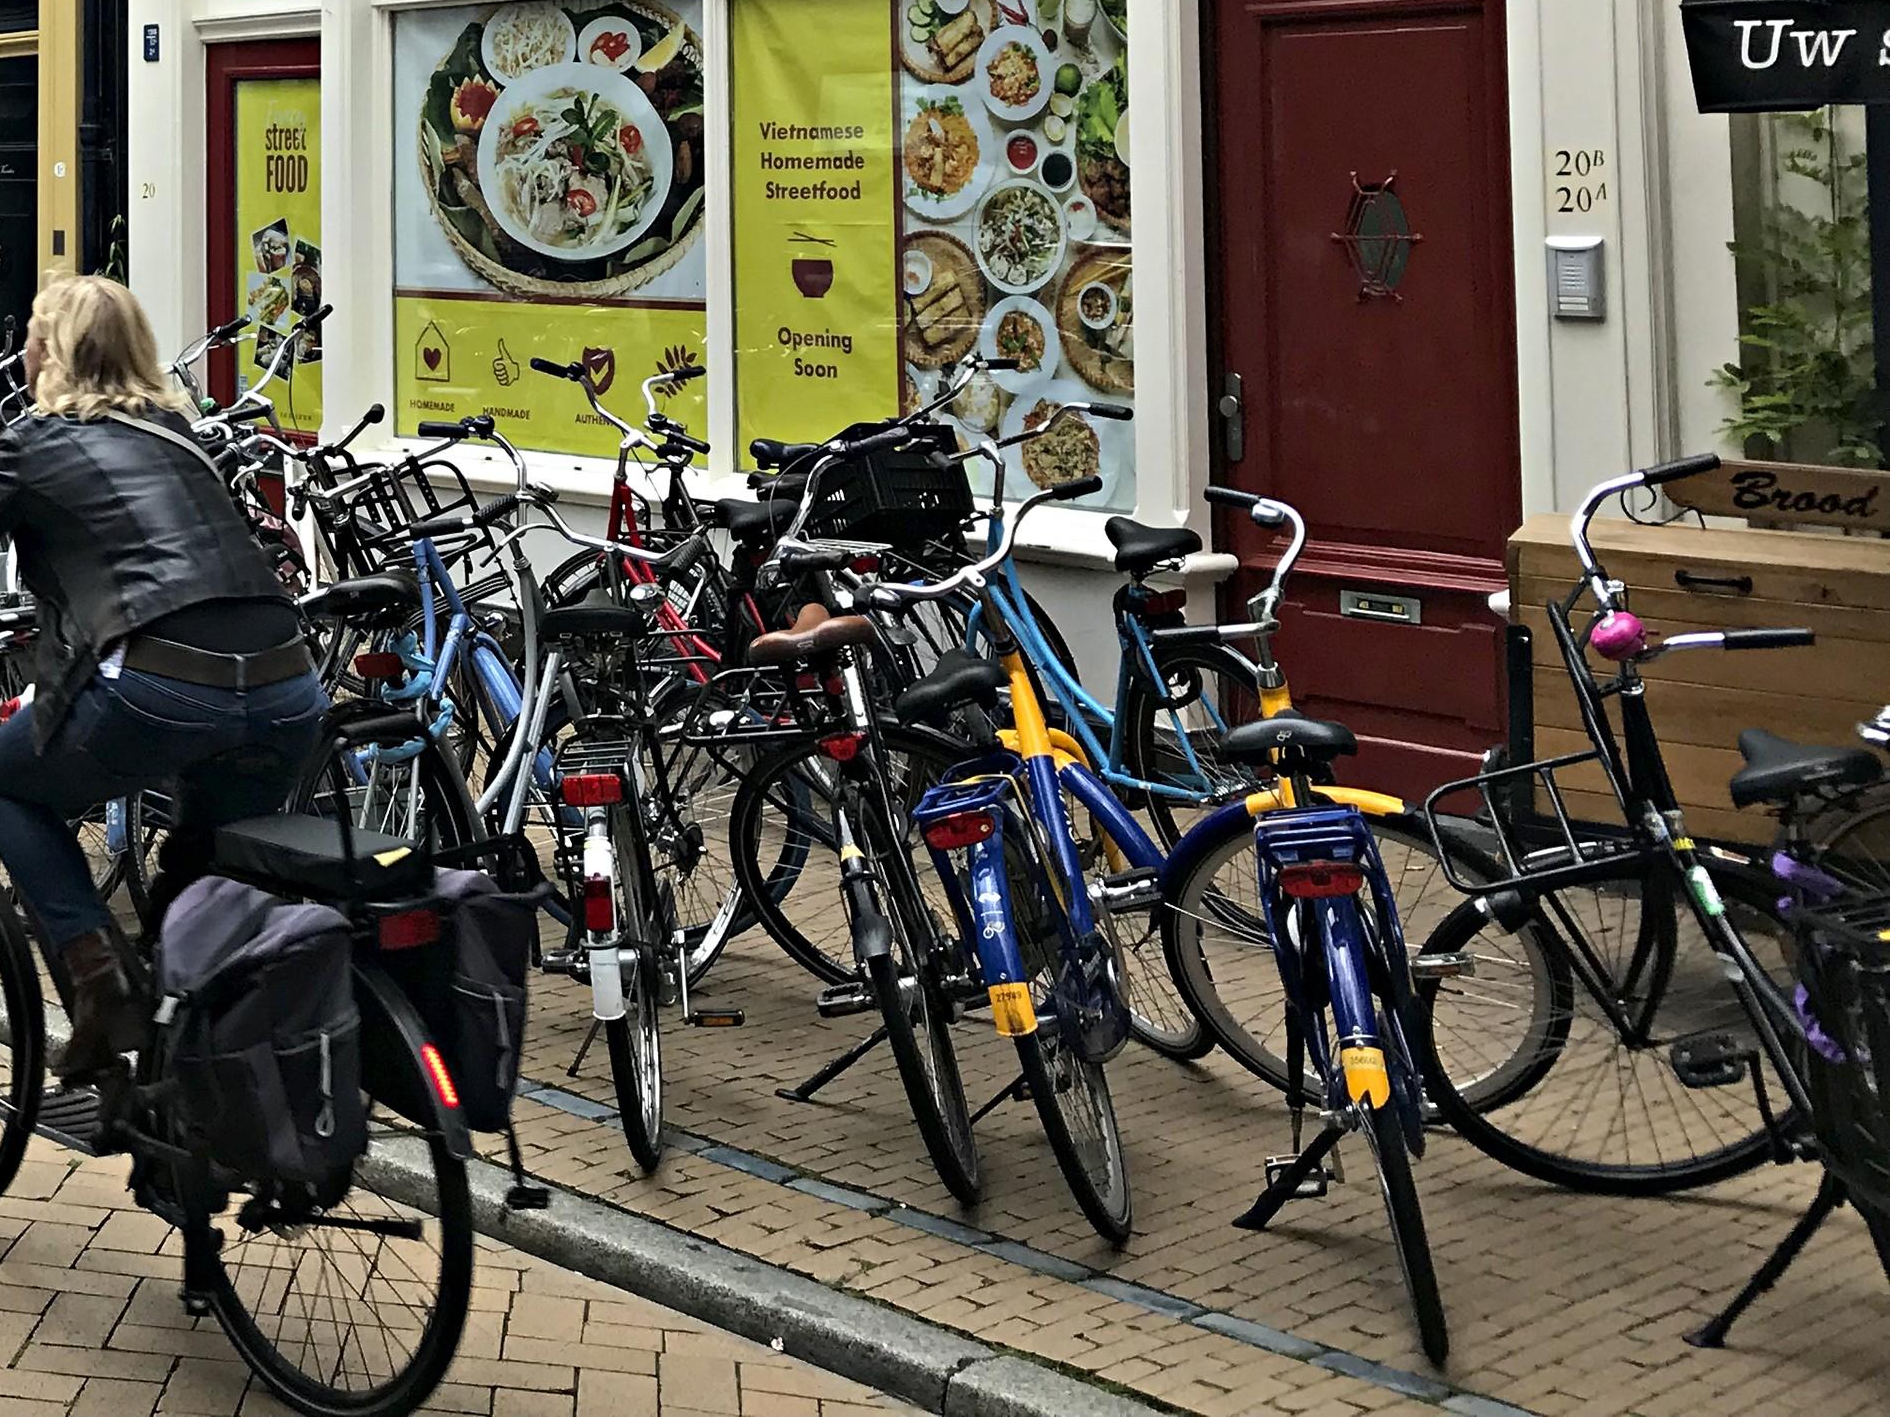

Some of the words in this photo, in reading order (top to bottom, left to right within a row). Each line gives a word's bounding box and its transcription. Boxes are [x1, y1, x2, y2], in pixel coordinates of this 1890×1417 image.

[1733, 18, 1857, 69] Uw
[265, 123, 307, 151] street
[759, 121, 864, 140] Vietnamese
[760, 149, 865, 170] Homemade
[265, 154, 309, 193] FOOD
[142, 182, 156, 199] 20
[765, 179, 861, 200] Streetfood
[777, 326, 853, 354] Opening
[794, 357, 838, 379] Soon
[409, 399, 456, 413] HOMEMADE
[482, 407, 531, 420] HANDMADE
[1729, 471, 1879, 518] Brood
